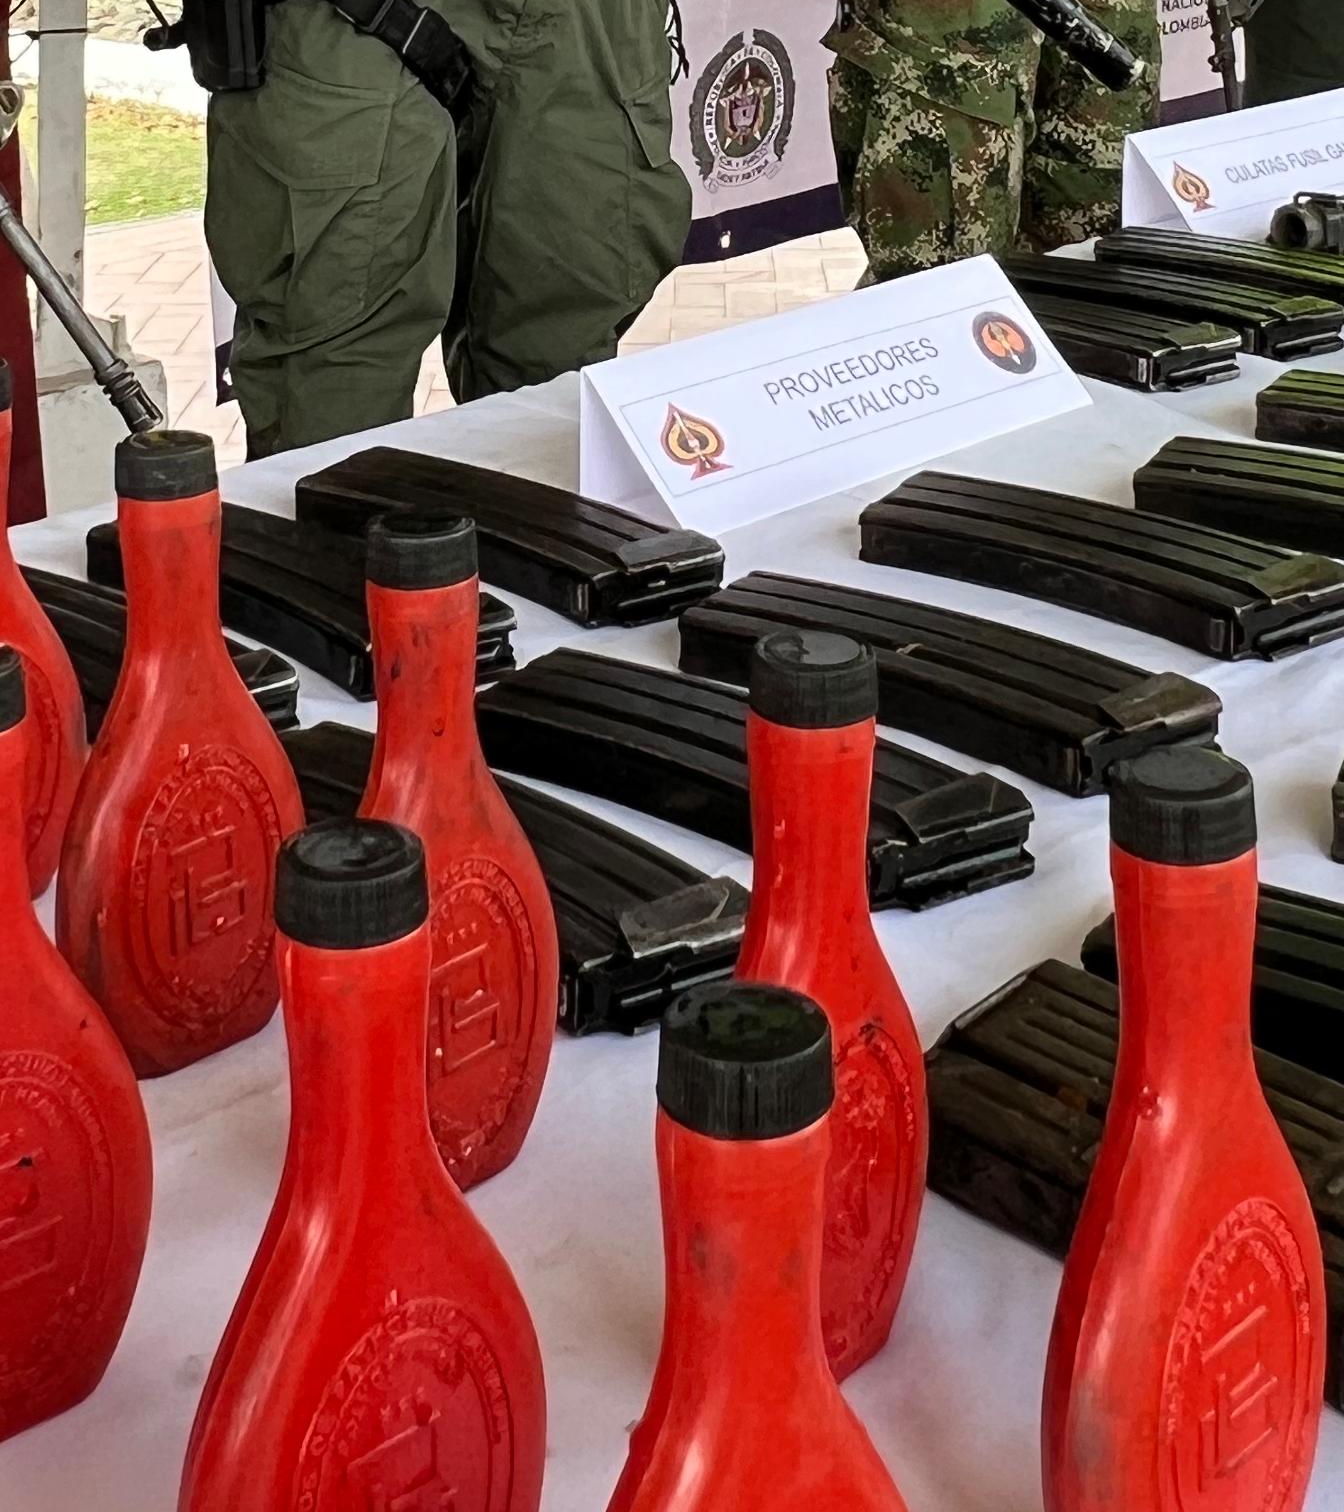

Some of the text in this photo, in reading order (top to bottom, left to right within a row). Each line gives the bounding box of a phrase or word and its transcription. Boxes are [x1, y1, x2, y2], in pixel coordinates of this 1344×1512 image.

[1225, 154, 1289, 184] CULATAS
[764, 337, 939, 406] PROVEEDORES
[808, 375, 940, 432] METALICOS
